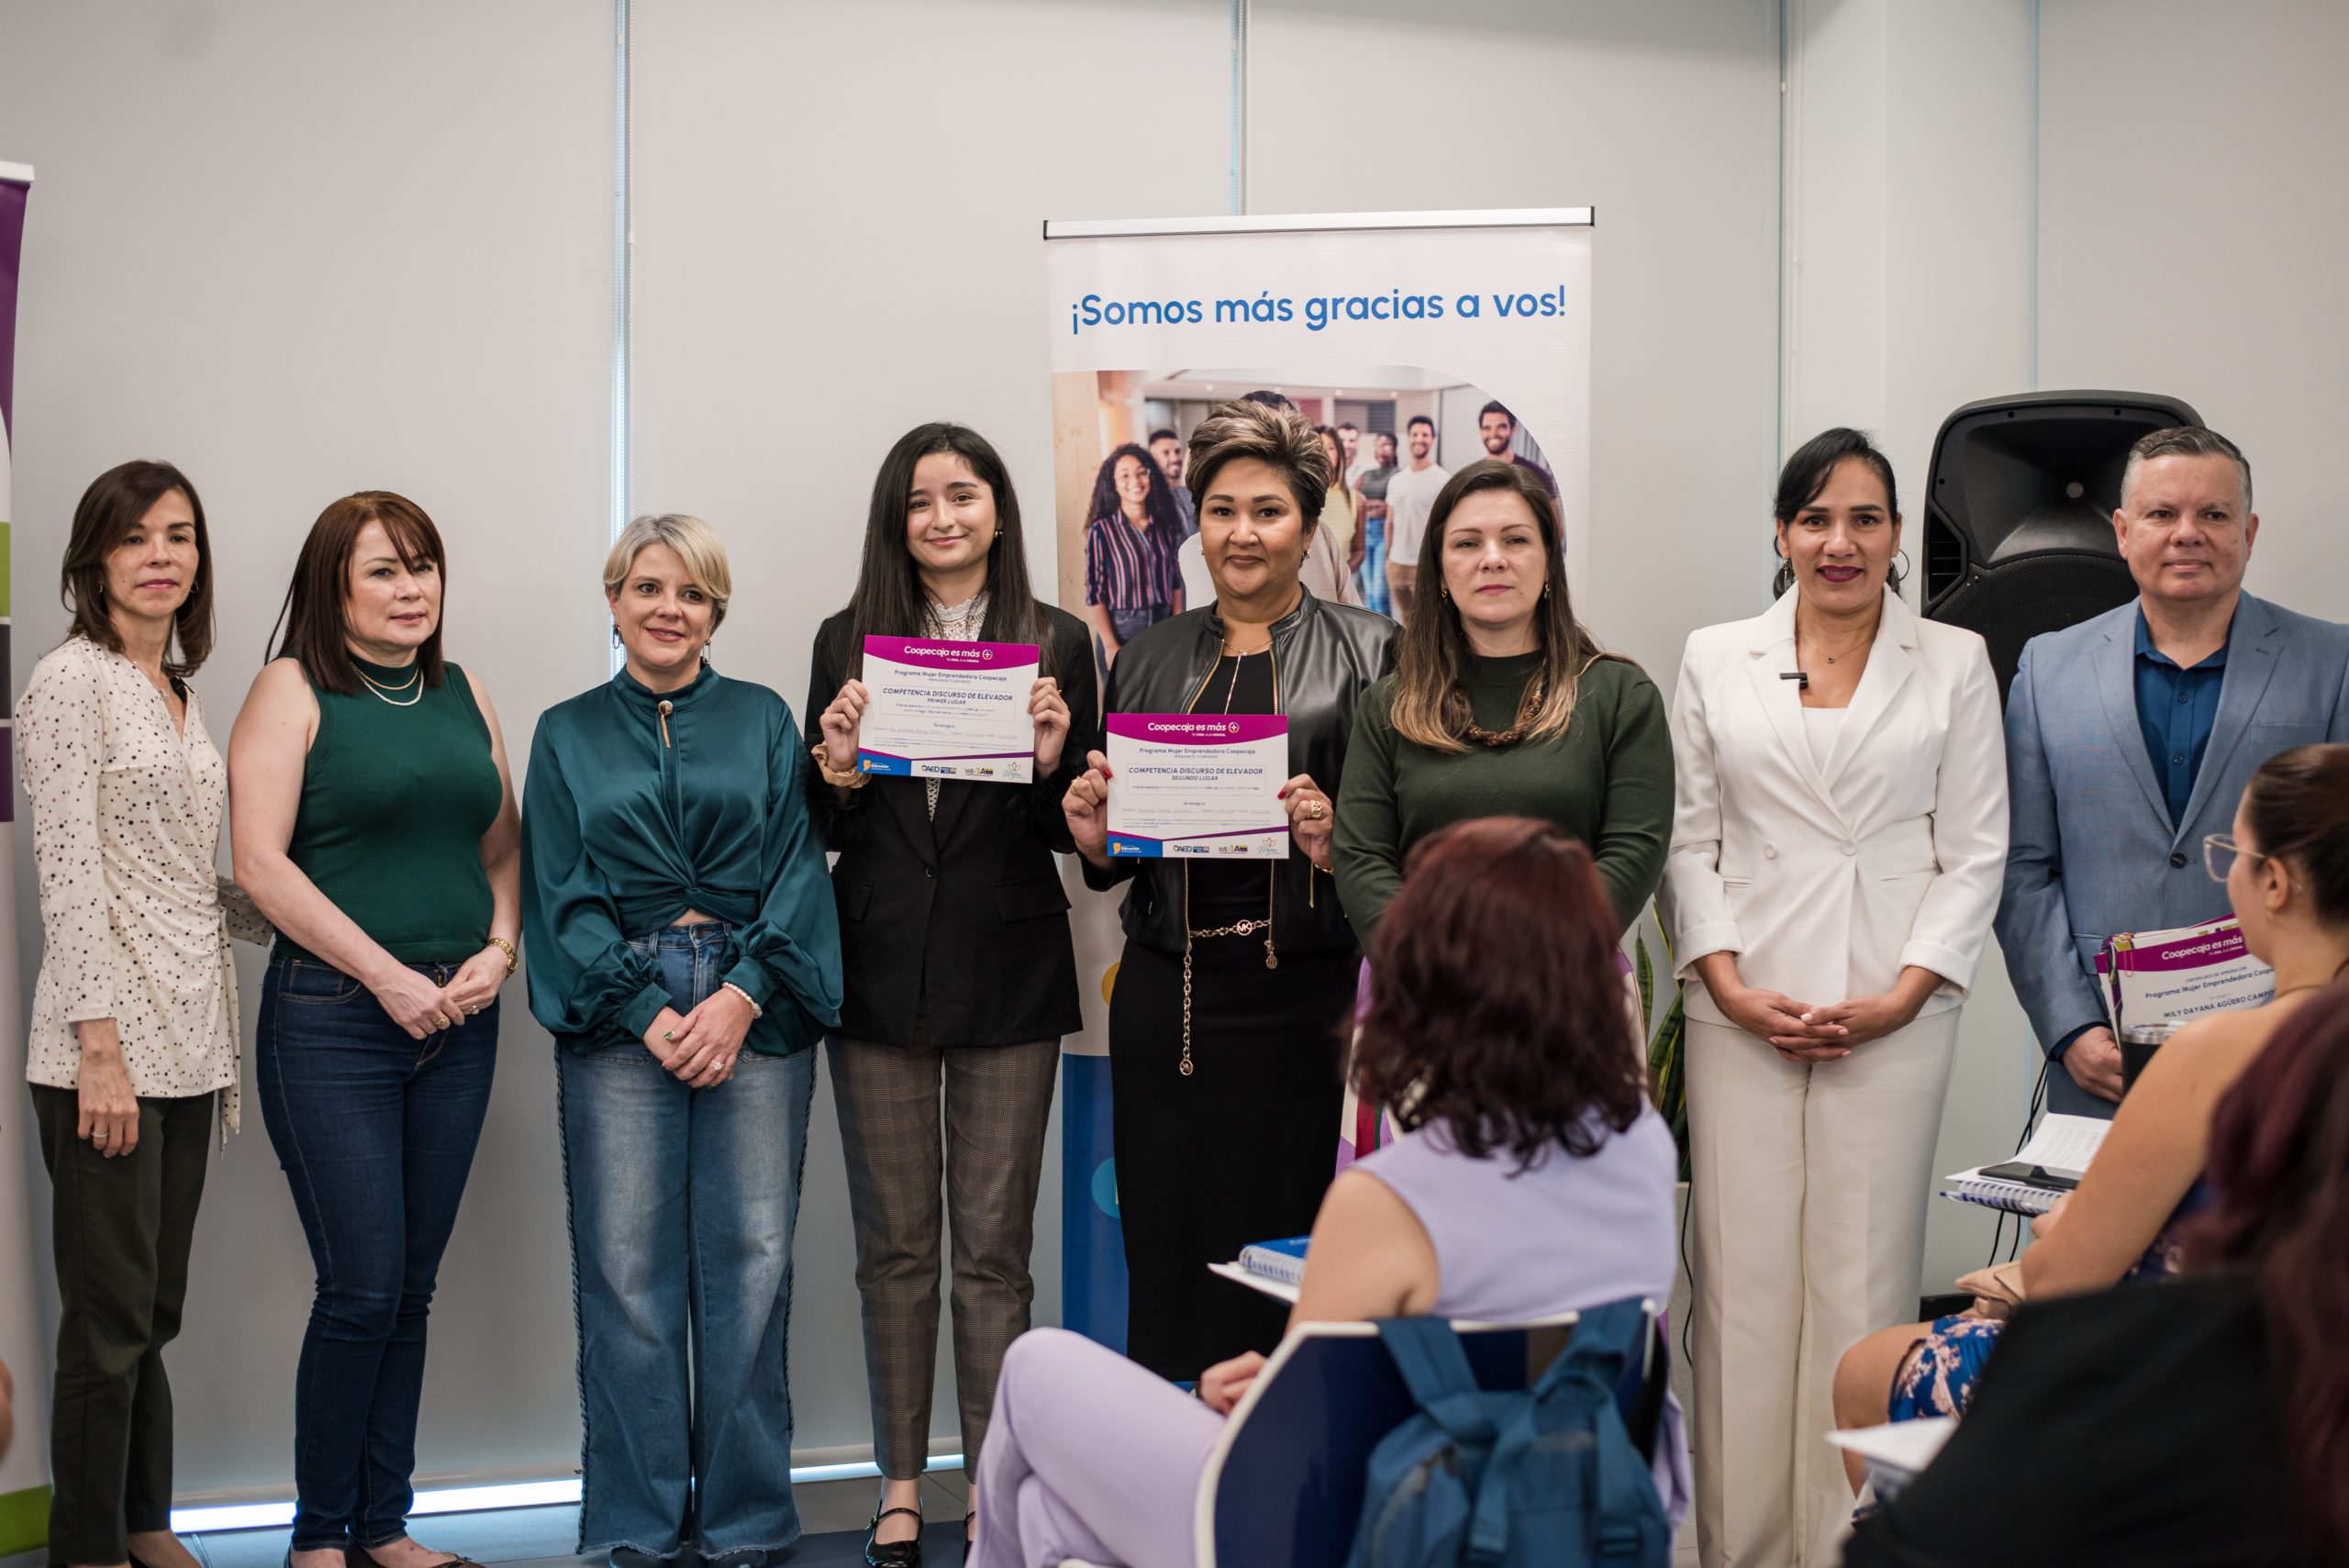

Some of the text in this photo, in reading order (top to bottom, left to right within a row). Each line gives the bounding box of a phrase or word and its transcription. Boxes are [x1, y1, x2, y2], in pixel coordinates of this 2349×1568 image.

[1072, 284, 1566, 335] ¡Somos más gracias a vos!
[904, 645, 981, 659] Coopecaja es más
[895, 670, 920, 678] Programa
[938, 673, 978, 681] Emprendedora
[883, 687, 931, 697] COMPETENCIA
[931, 690, 967, 699] DISCURSO
[977, 693, 1013, 701] ELEVADOR
[1147, 722, 1195, 732] Coopecaja
[1207, 722, 1227, 731] más
[1139, 748, 1166, 756] Programa
[1168, 748, 1184, 756] Mujer
[1184, 748, 1225, 756] Emprendedora
[1226, 767, 1264, 775] ELEVADOR
[2161, 934, 2243, 961] Coopecaja es más
[2145, 988, 2180, 999] Programa
[2181, 984, 2201, 995] Mujer
[2202, 973, 2253, 990] Emprendedora
[2164, 1006, 2182, 1018] MILY
[2183, 1001, 2215, 1015] DAYANA
[2216, 995, 2246, 1007] AGÜERO
[2247, 989, 2276, 1001] CAMPO
